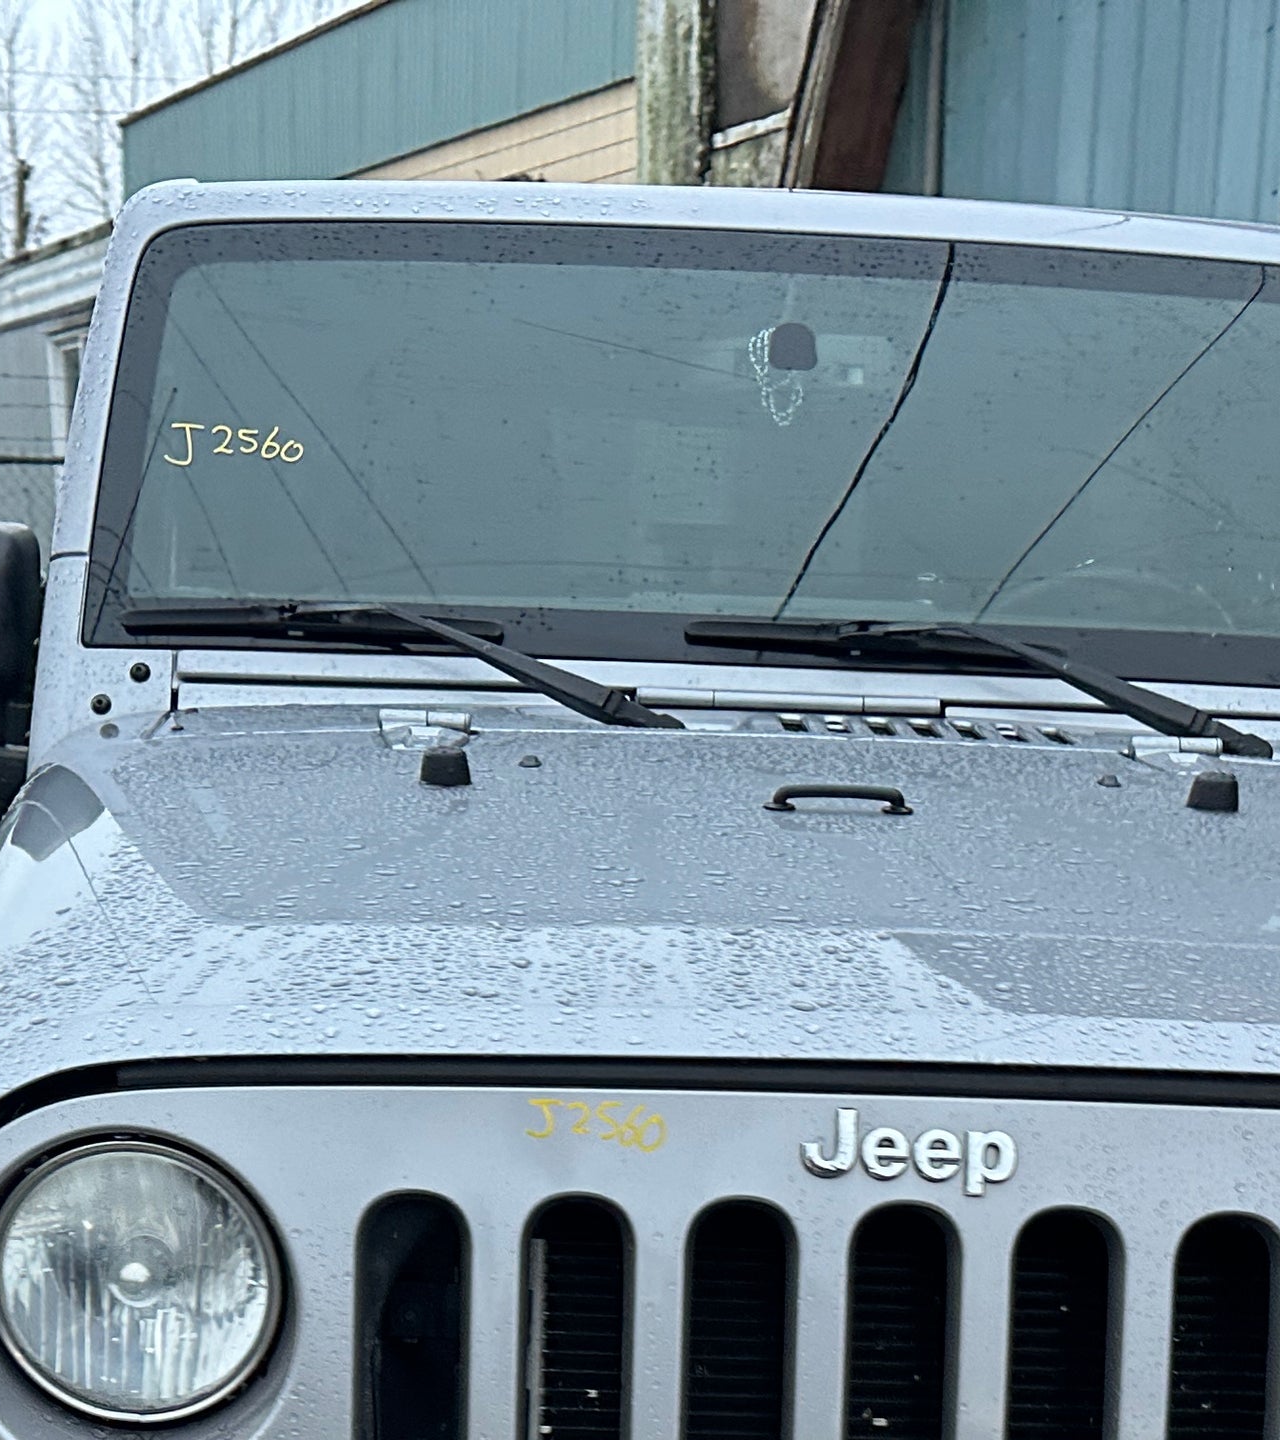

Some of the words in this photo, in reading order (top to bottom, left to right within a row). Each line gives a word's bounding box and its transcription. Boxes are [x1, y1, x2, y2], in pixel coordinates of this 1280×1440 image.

[163, 422, 305, 467] J2560
[525, 1098, 667, 1153] J2560
[800, 1106, 1019, 1197] Jeep
